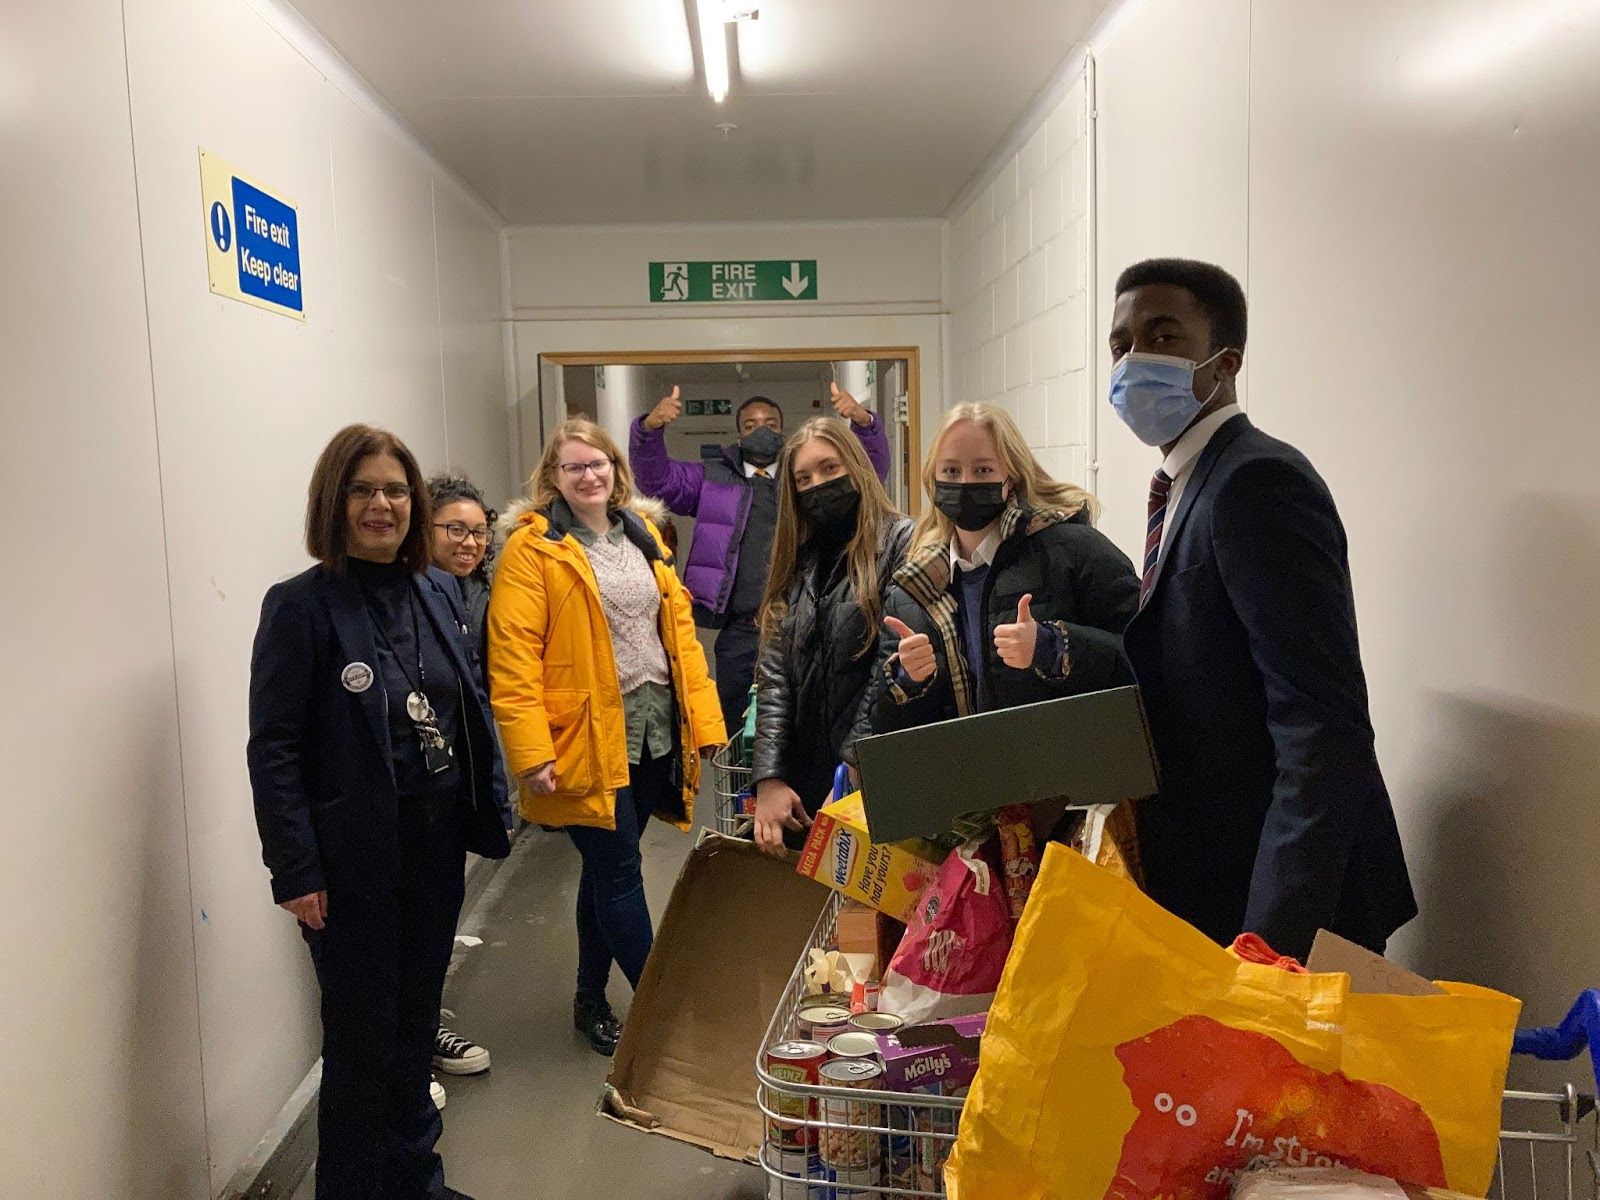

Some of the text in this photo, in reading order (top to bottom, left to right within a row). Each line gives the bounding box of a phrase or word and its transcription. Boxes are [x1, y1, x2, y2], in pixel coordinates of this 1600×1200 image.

[244, 204, 291, 249] Fire exit
[241, 246, 299, 291] Keep clear
[711, 264, 756, 280] FIRE
[712, 282, 757, 299] EXIT
[801, 852, 818, 876] MEGA
[810, 826, 827, 851] PACK
[857, 845, 879, 894] Have you
[869, 846, 893, 906] had yours?
[904, 1052, 952, 1081] Molly's
[1225, 1108, 1265, 1150] I'm
